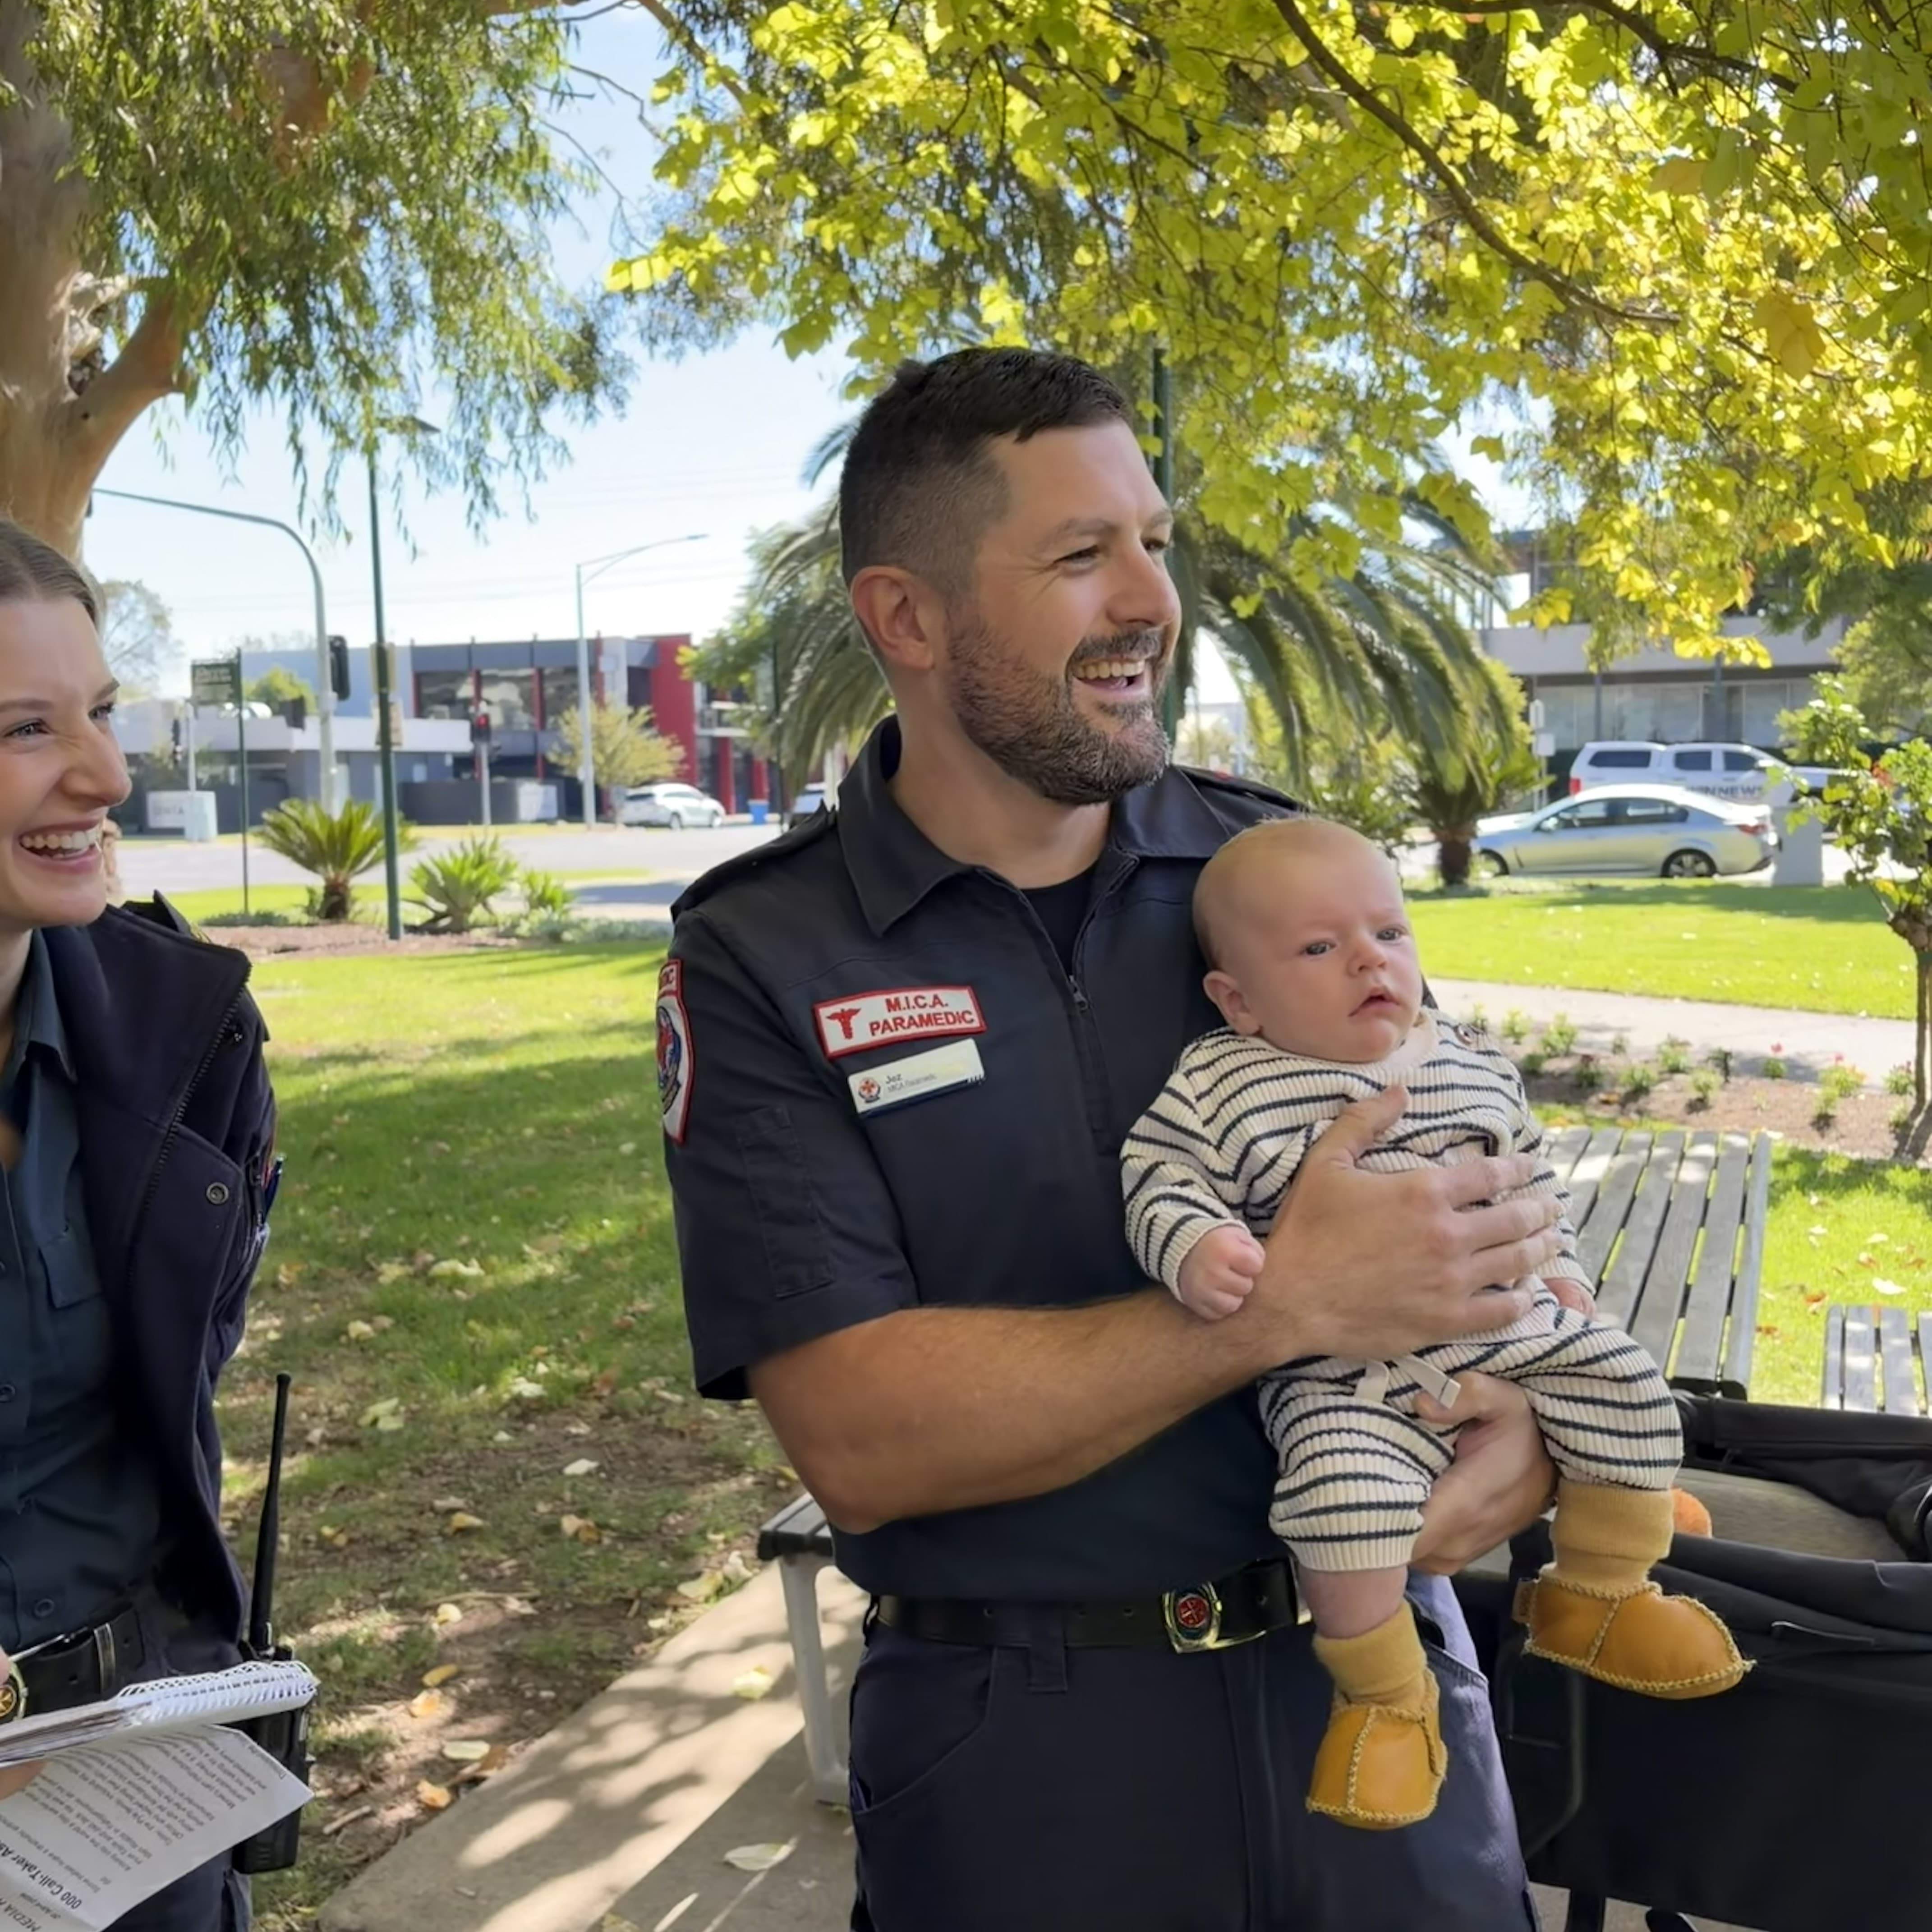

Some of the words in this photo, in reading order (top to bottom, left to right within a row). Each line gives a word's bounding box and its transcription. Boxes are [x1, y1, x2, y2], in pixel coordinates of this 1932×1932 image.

[885, 994, 948, 1013] M.I.C.A.
[869, 1010, 975, 1036] PARAMEDIC
[886, 1073, 902, 1084] Jez
[60, 1891, 82, 1909] 000
